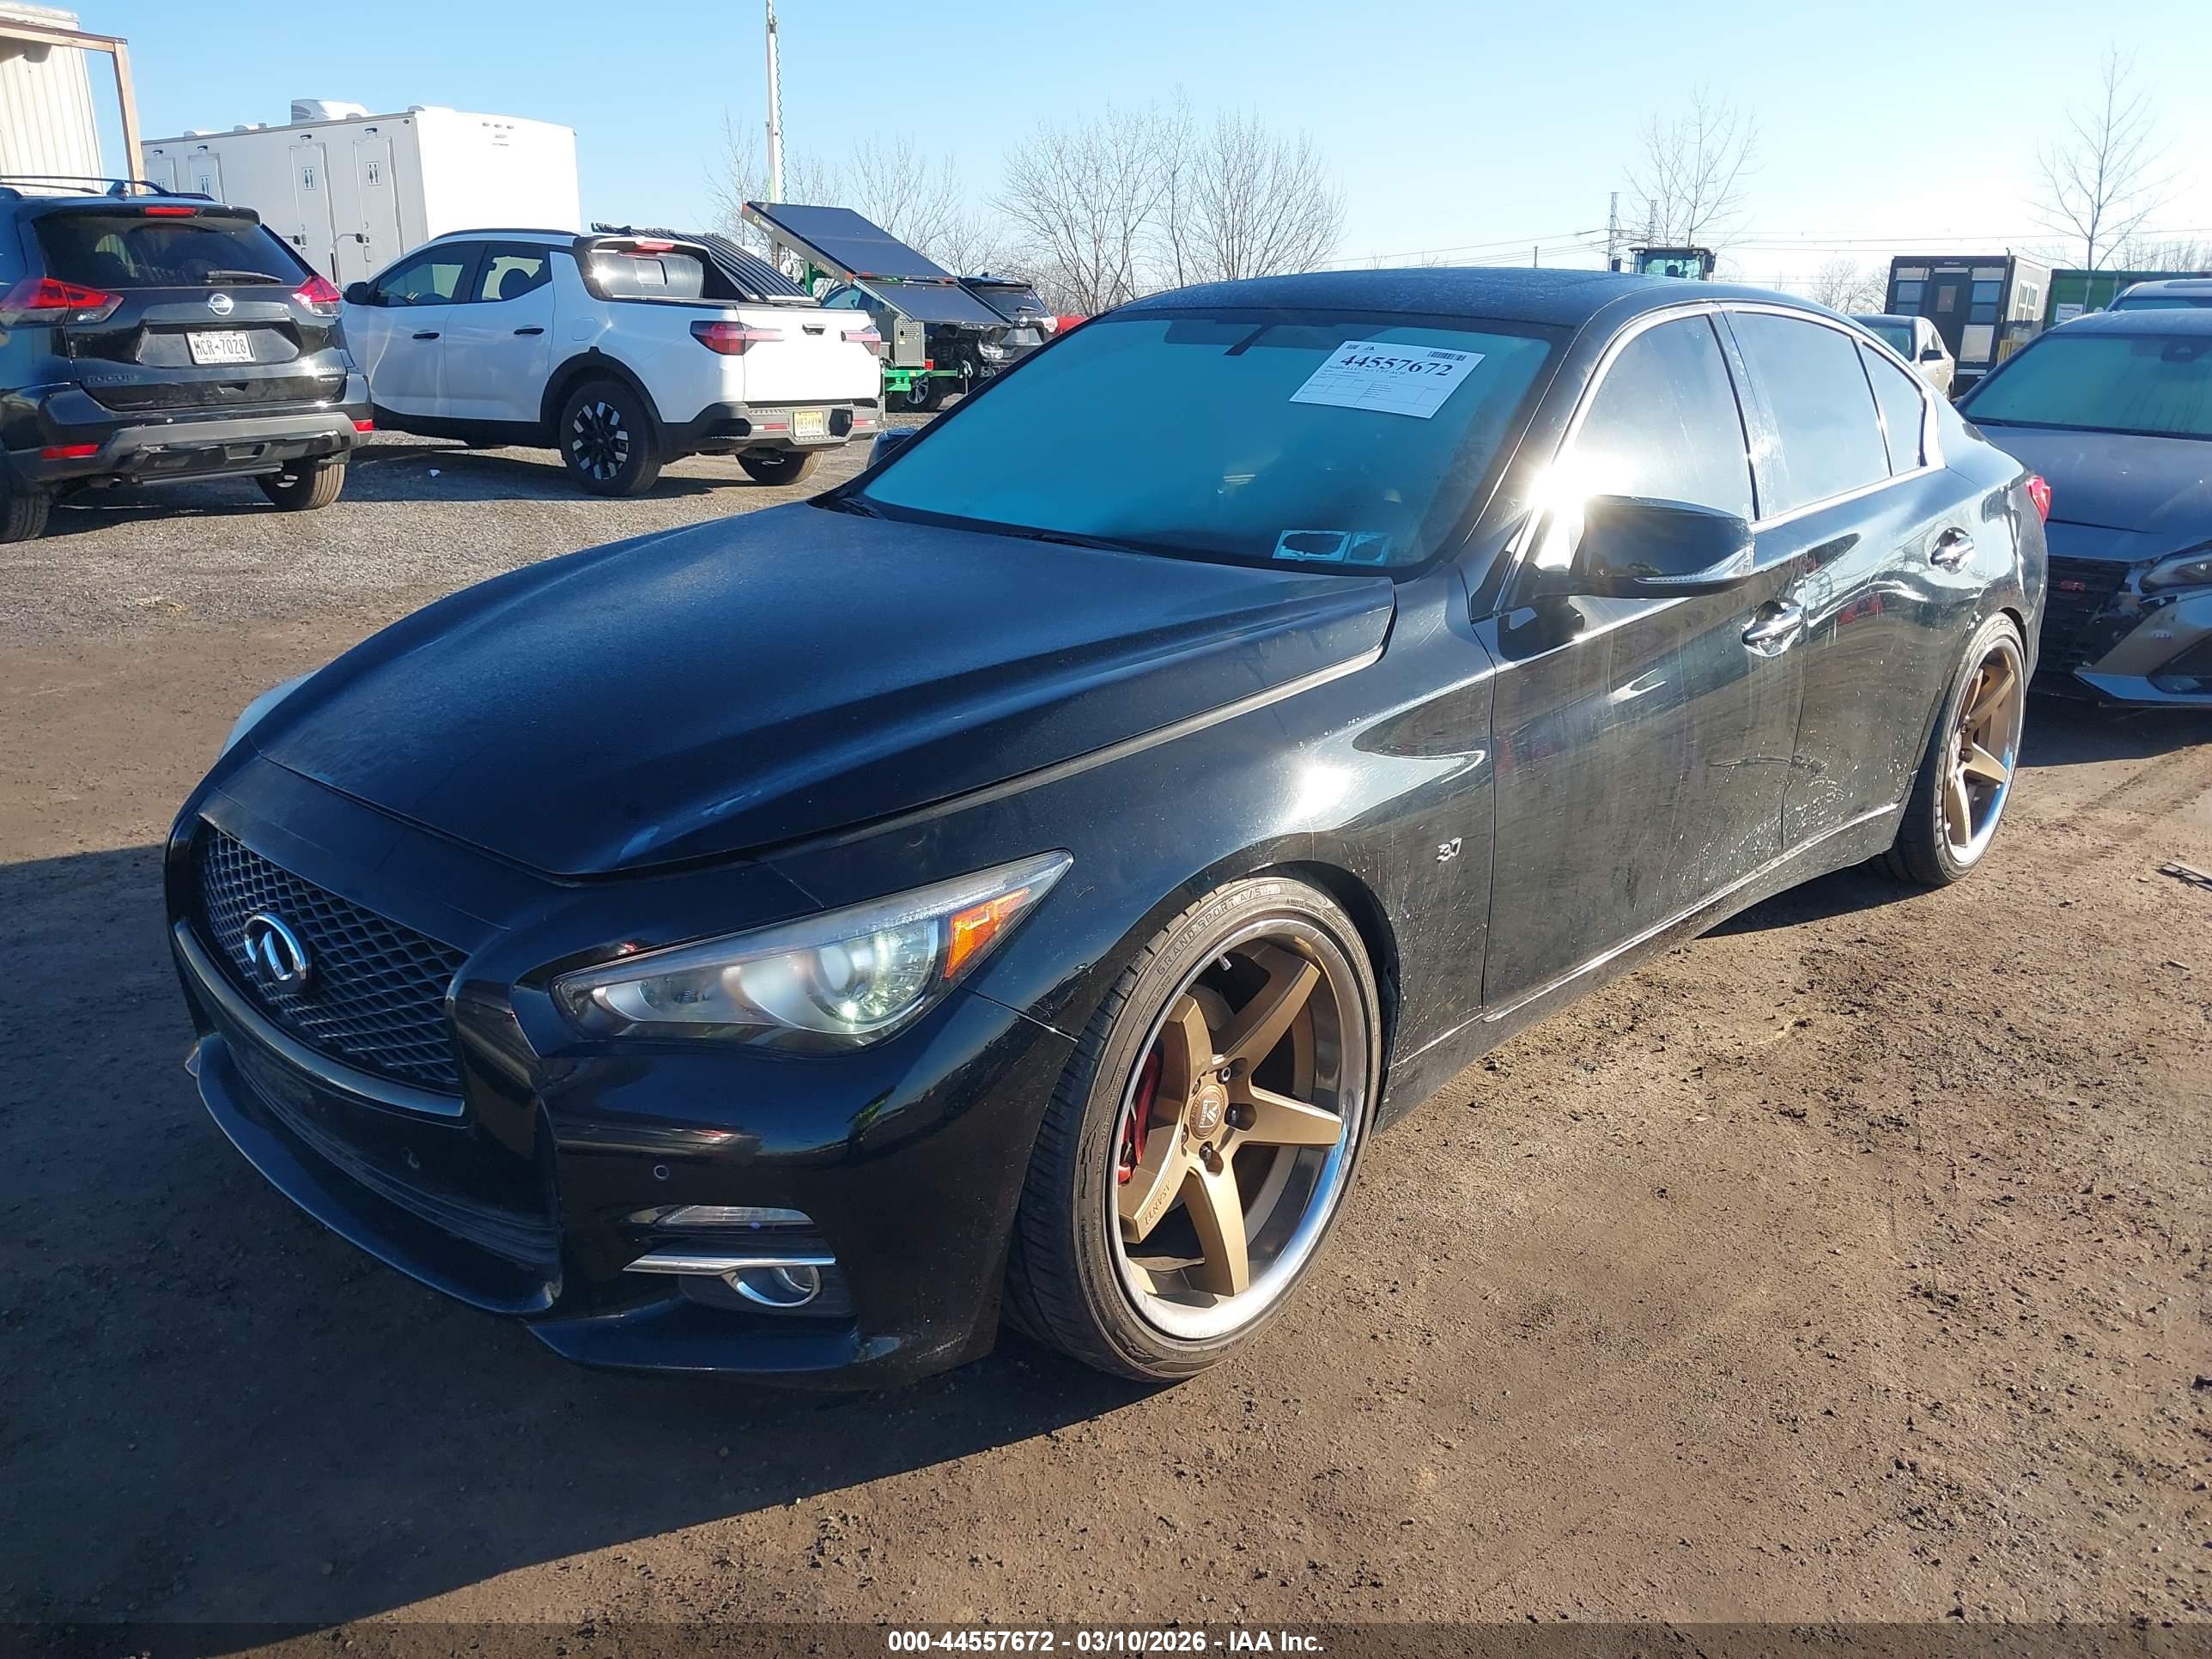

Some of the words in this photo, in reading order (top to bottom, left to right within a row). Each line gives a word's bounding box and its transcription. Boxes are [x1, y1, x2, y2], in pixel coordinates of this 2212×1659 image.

[1340, 355, 1453, 376] 44557672
[1158, 929, 1196, 975] GRAND
[1197, 896, 1236, 931] SPORT
